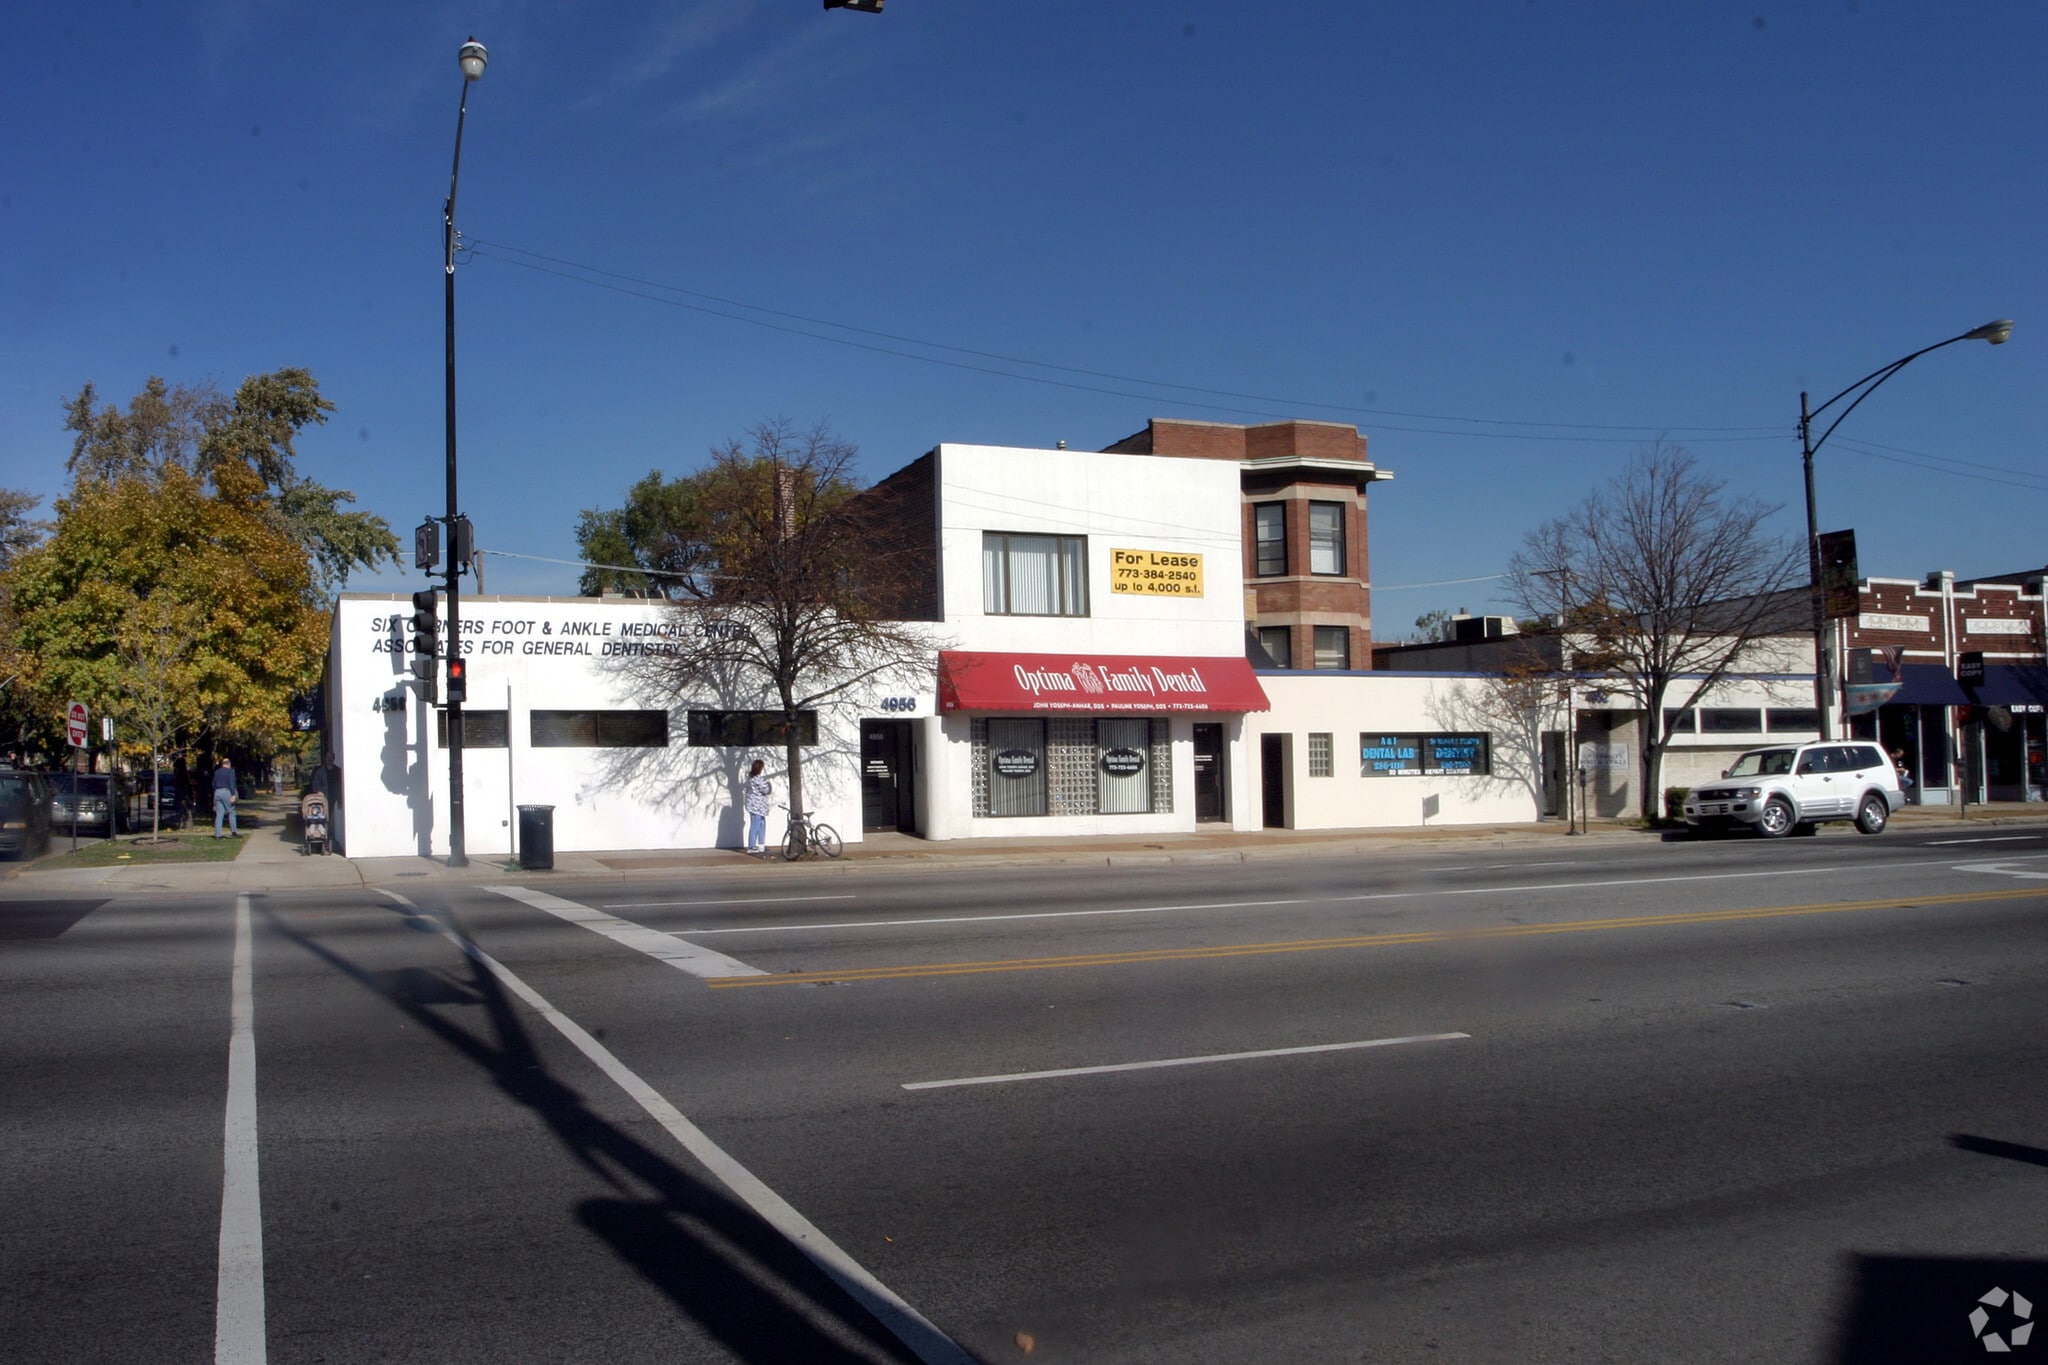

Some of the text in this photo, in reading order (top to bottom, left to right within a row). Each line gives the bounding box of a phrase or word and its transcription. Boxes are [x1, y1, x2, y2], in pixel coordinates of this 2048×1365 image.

[1115, 552, 1198, 567] For Lease
[1118, 568, 1196, 580] 773-384-2540
[1115, 583, 1128, 592] up
[1148, 583, 1180, 593] 4,000
[371, 618, 398, 632] SIX
[491, 620, 536, 635] FOOT
[542, 621, 552, 635] &
[560, 622, 612, 636] ANKLE
[620, 623, 684, 637] MEDICAL
[694, 624, 751, 638] CENTER
[481, 641, 514, 654] FOR
[522, 641, 593, 655] GENERAL
[601, 642, 682, 656] DENTISTRY
[1960, 662, 1982, 670] EASY
[1014, 664, 1207, 697] Optima Family Dental
[880, 697, 917, 712] 4956
[1363, 748, 1415, 759] DENTAL LAB
